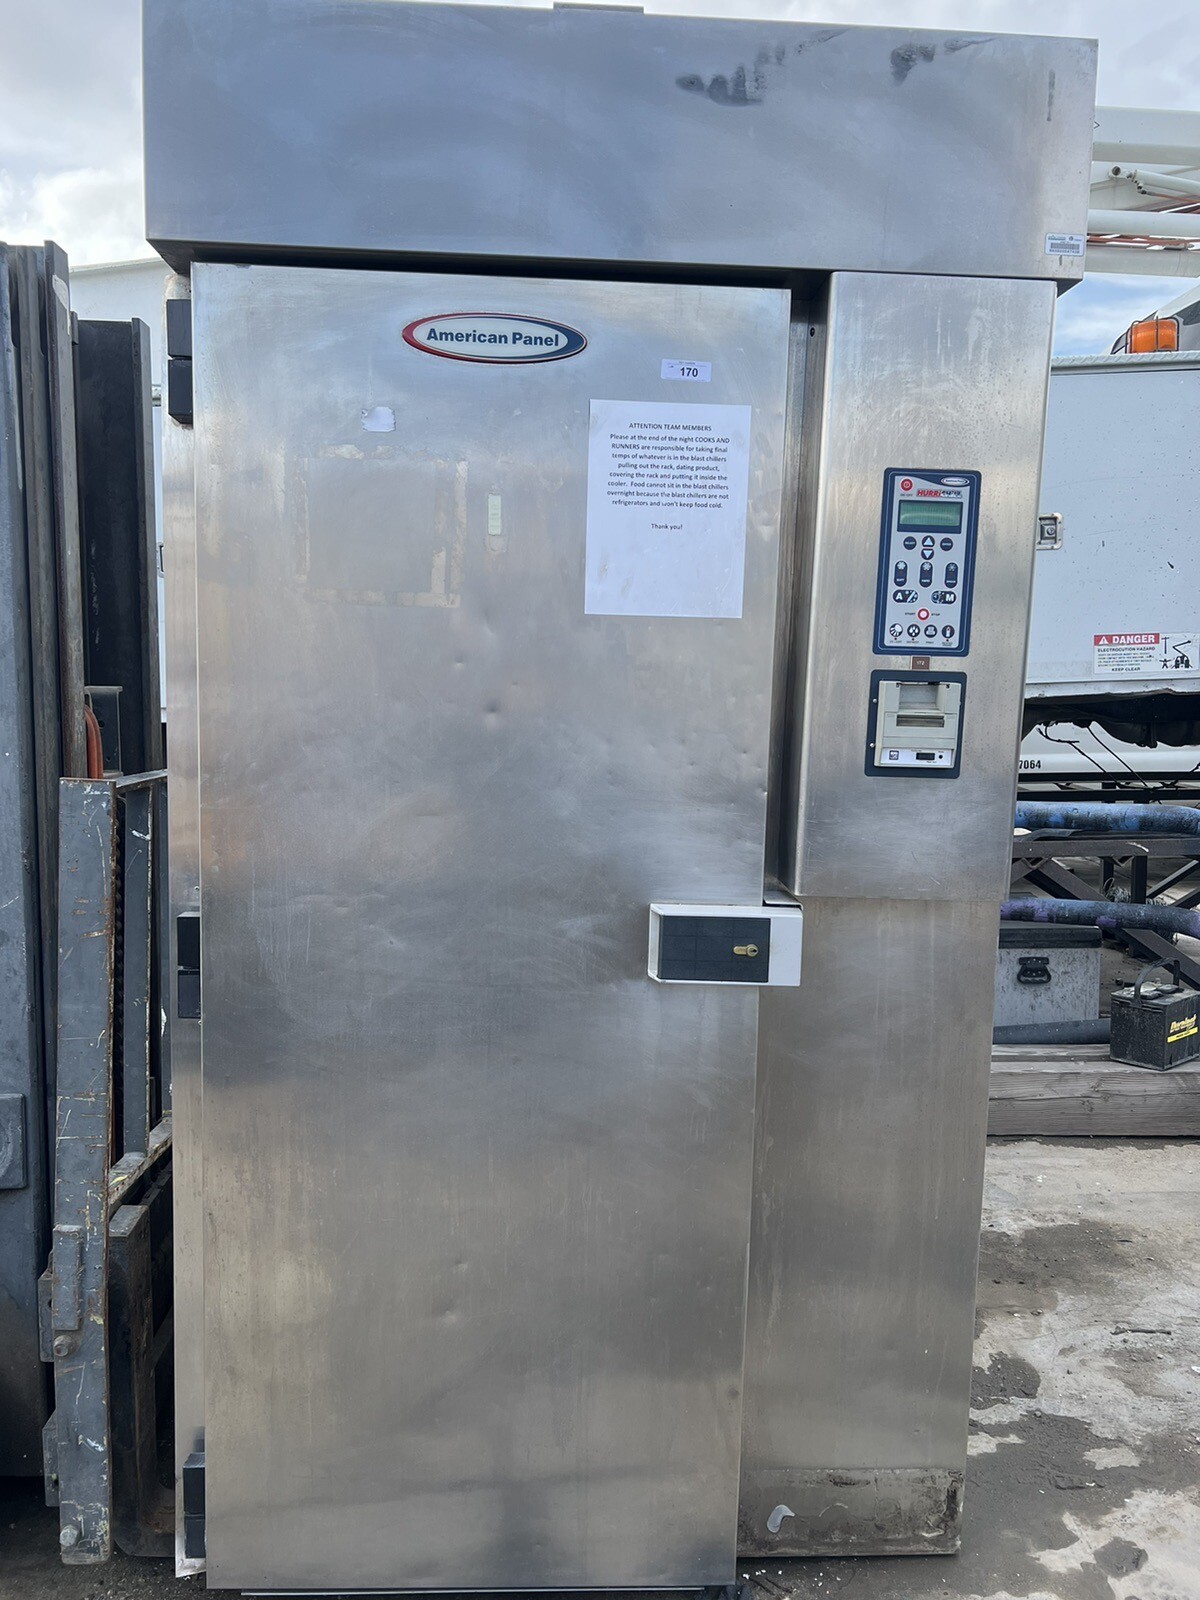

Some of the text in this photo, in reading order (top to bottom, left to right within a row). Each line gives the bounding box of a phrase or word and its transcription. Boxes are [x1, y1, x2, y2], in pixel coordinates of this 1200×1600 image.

[426, 328, 559, 346] American Panel
[680, 367, 698, 377] 170
[679, 435, 694, 444] night
[652, 444, 684, 453] responsible
[696, 445, 713, 454] taking
[612, 452, 630, 460] temps
[618, 462, 638, 471] pulling
[662, 463, 674, 472] rack,
[676, 464, 694, 472] dating
[696, 464, 720, 473] product,
[609, 471, 634, 480] covering
[672, 473, 692, 481] putting
[607, 490, 634, 498] overnight
[612, 499, 648, 508] refrigerators
[679, 501, 693, 509] keep
[670, 523, 682, 531] you!
[1112, 635, 1155, 644] DANGER
[1019, 760, 1041, 769] 7064
